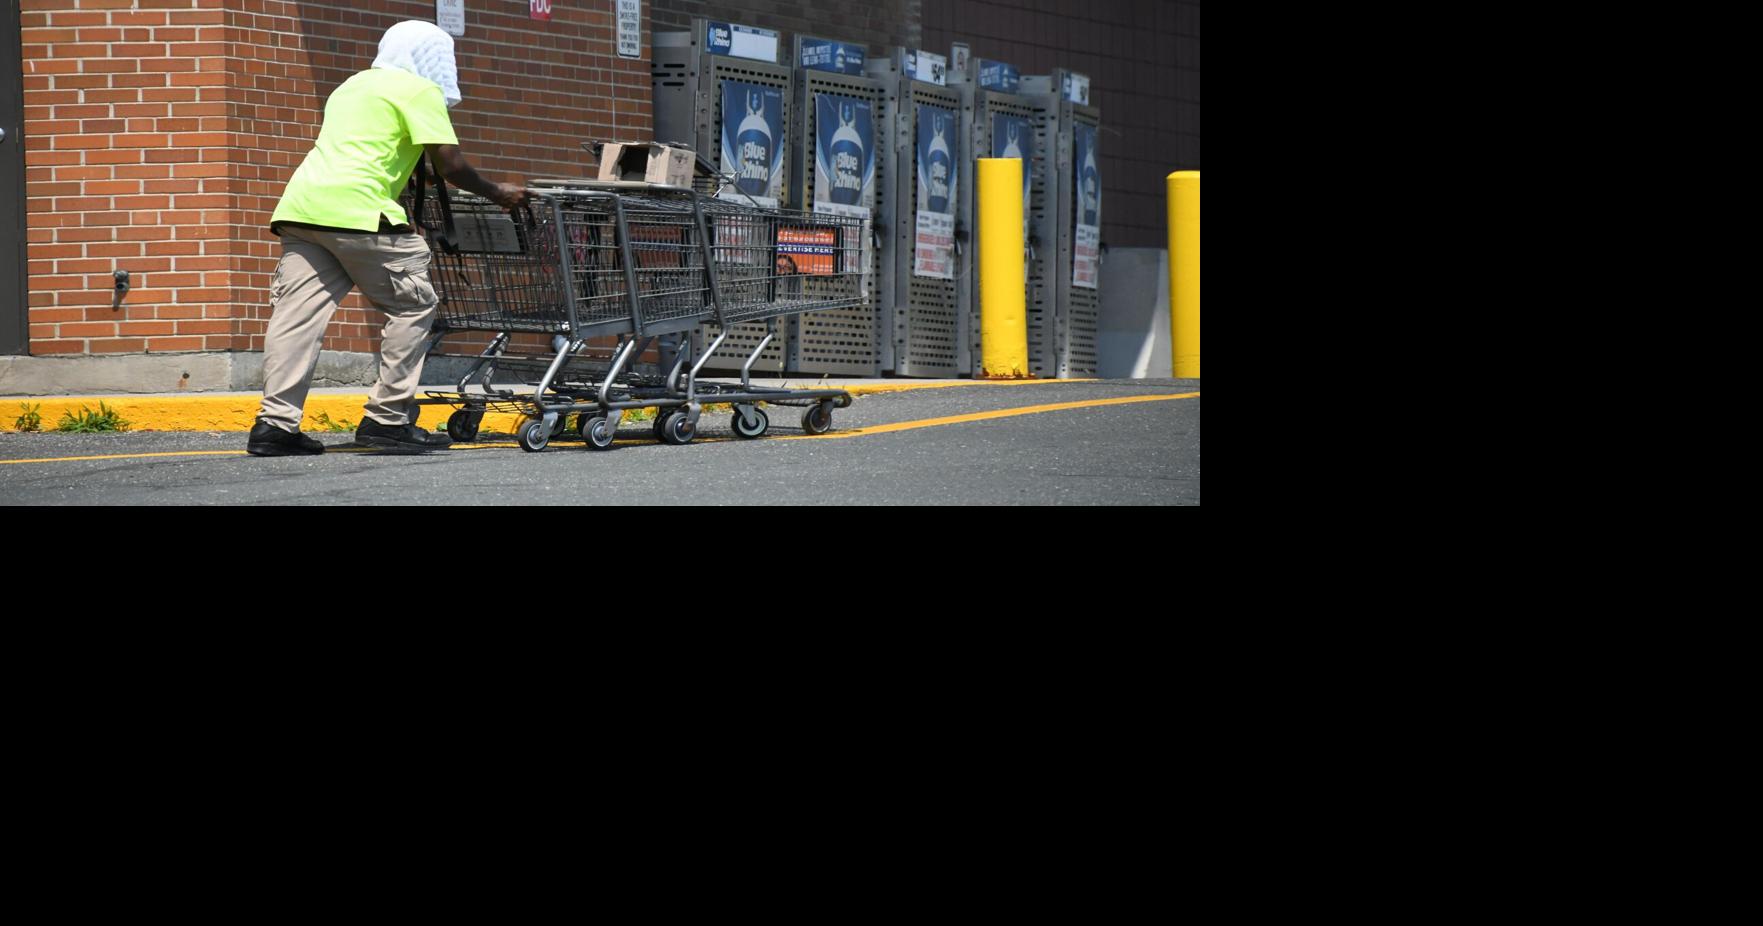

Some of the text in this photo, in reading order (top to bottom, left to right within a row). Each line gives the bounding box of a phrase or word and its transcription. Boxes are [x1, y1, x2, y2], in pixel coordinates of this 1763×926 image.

[715, 28, 728, 38] Blue
[744, 141, 766, 161] Blue
[837, 152, 858, 170] Blue
[740, 161, 769, 182] Rhino
[834, 170, 861, 191] Rhino
